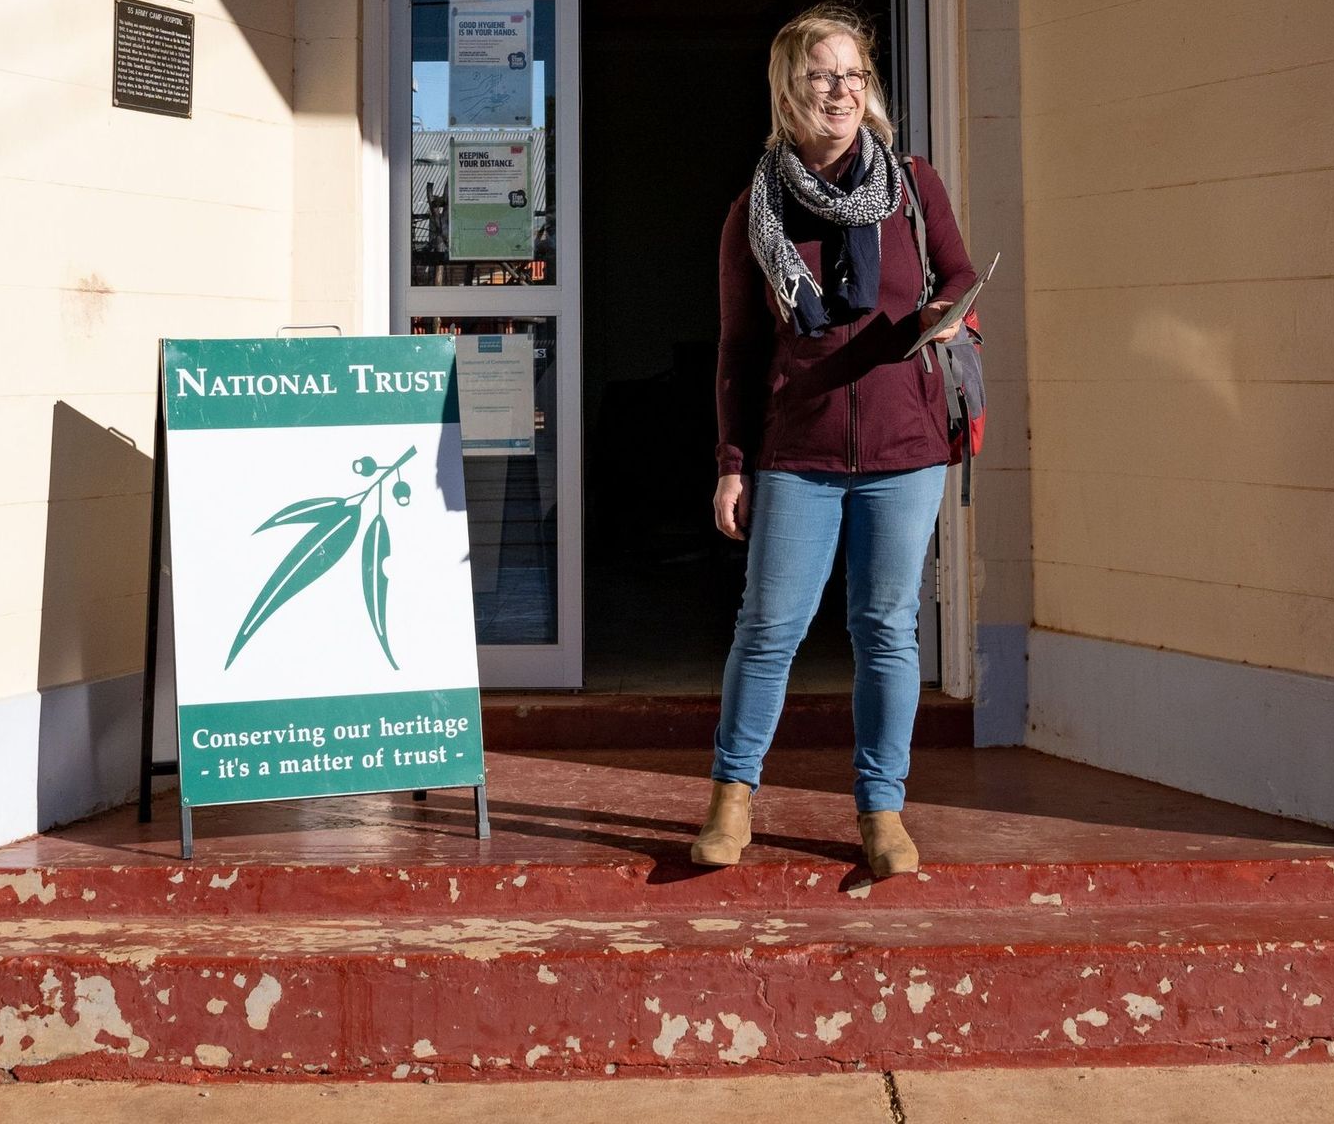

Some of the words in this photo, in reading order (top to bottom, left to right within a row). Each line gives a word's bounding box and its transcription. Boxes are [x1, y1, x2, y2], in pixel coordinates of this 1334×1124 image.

[135, 9, 149, 18] ARMY
[149, 12, 163, 21] CAMP
[163, 15, 184, 26] HOSPITAL
[459, 21, 477, 29] GOOD
[478, 21, 506, 29] HYGIENE
[176, 368, 337, 397] NATIONAL
[348, 364, 446, 394] TRUST
[192, 725, 327, 750] Conserving
[333, 723, 371, 741] our
[379, 714, 469, 738] heritage
[218, 757, 250, 779] it's
[258, 761, 270, 776] a
[279, 753, 354, 774] matter
[362, 747, 385, 769] of
[393, 745, 447, 766] trust
